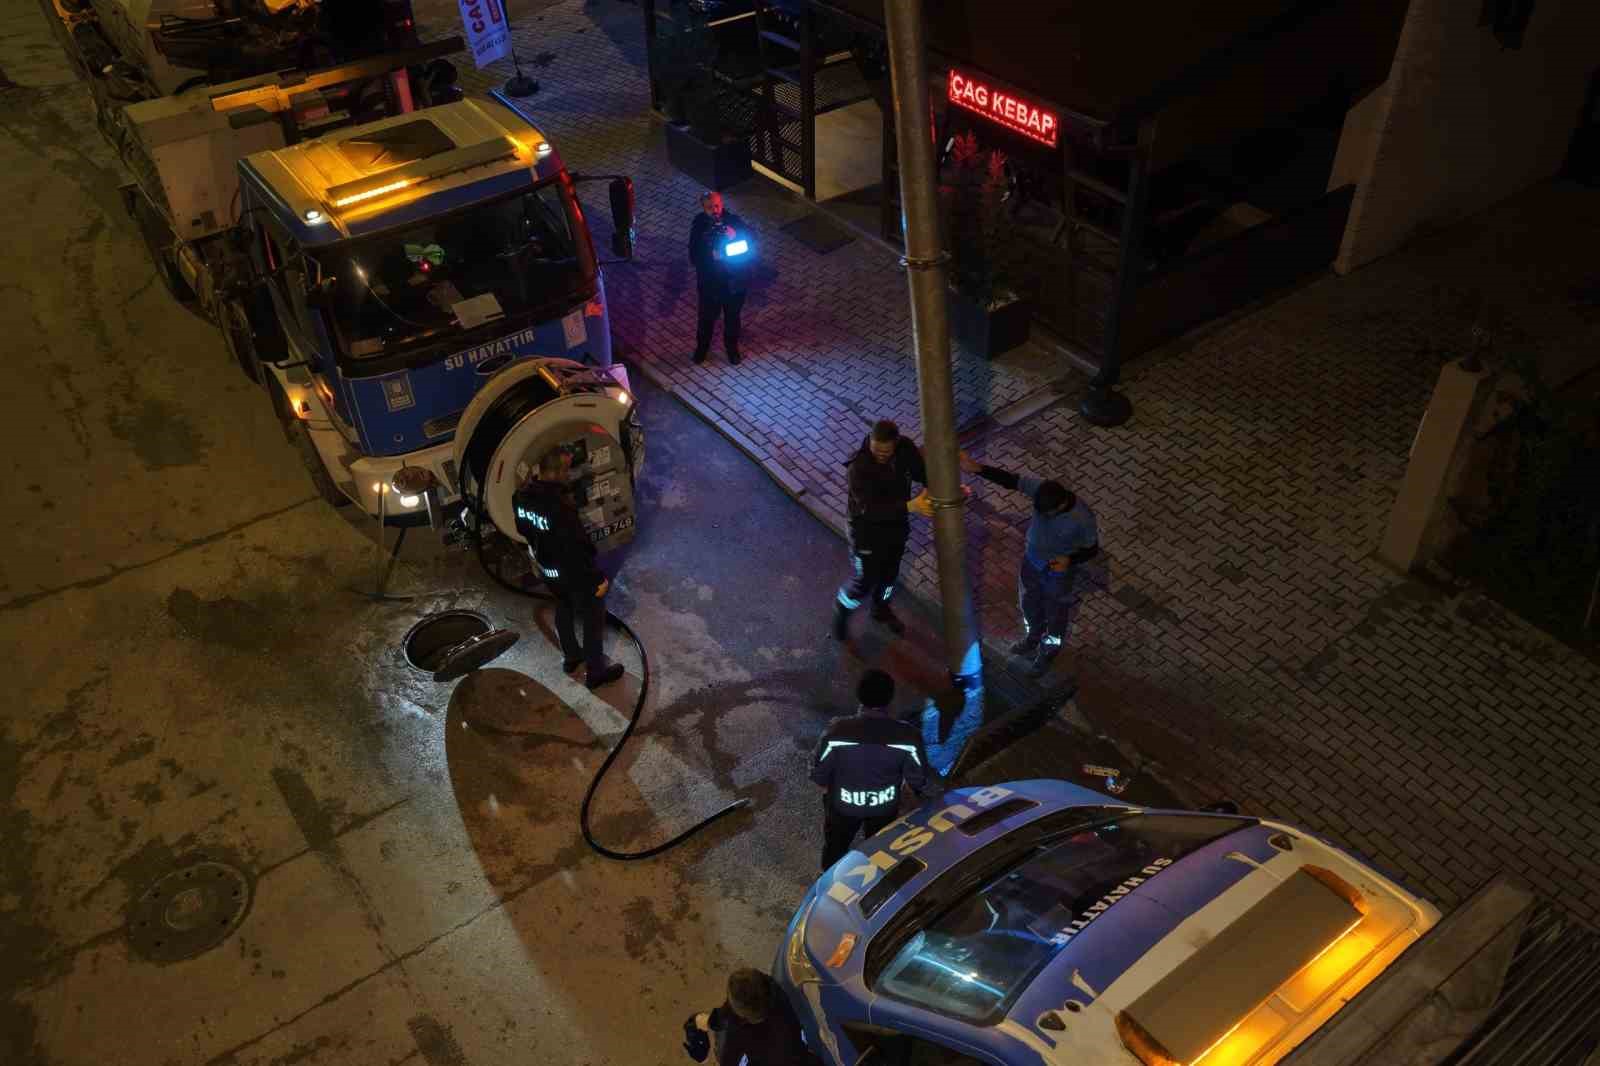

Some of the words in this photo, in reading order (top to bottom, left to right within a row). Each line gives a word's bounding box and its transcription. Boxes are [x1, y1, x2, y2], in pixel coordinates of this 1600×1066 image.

[992, 91, 1053, 134] KEBAP
[443, 355, 465, 371] SU
[1140, 857, 1174, 875] SU
